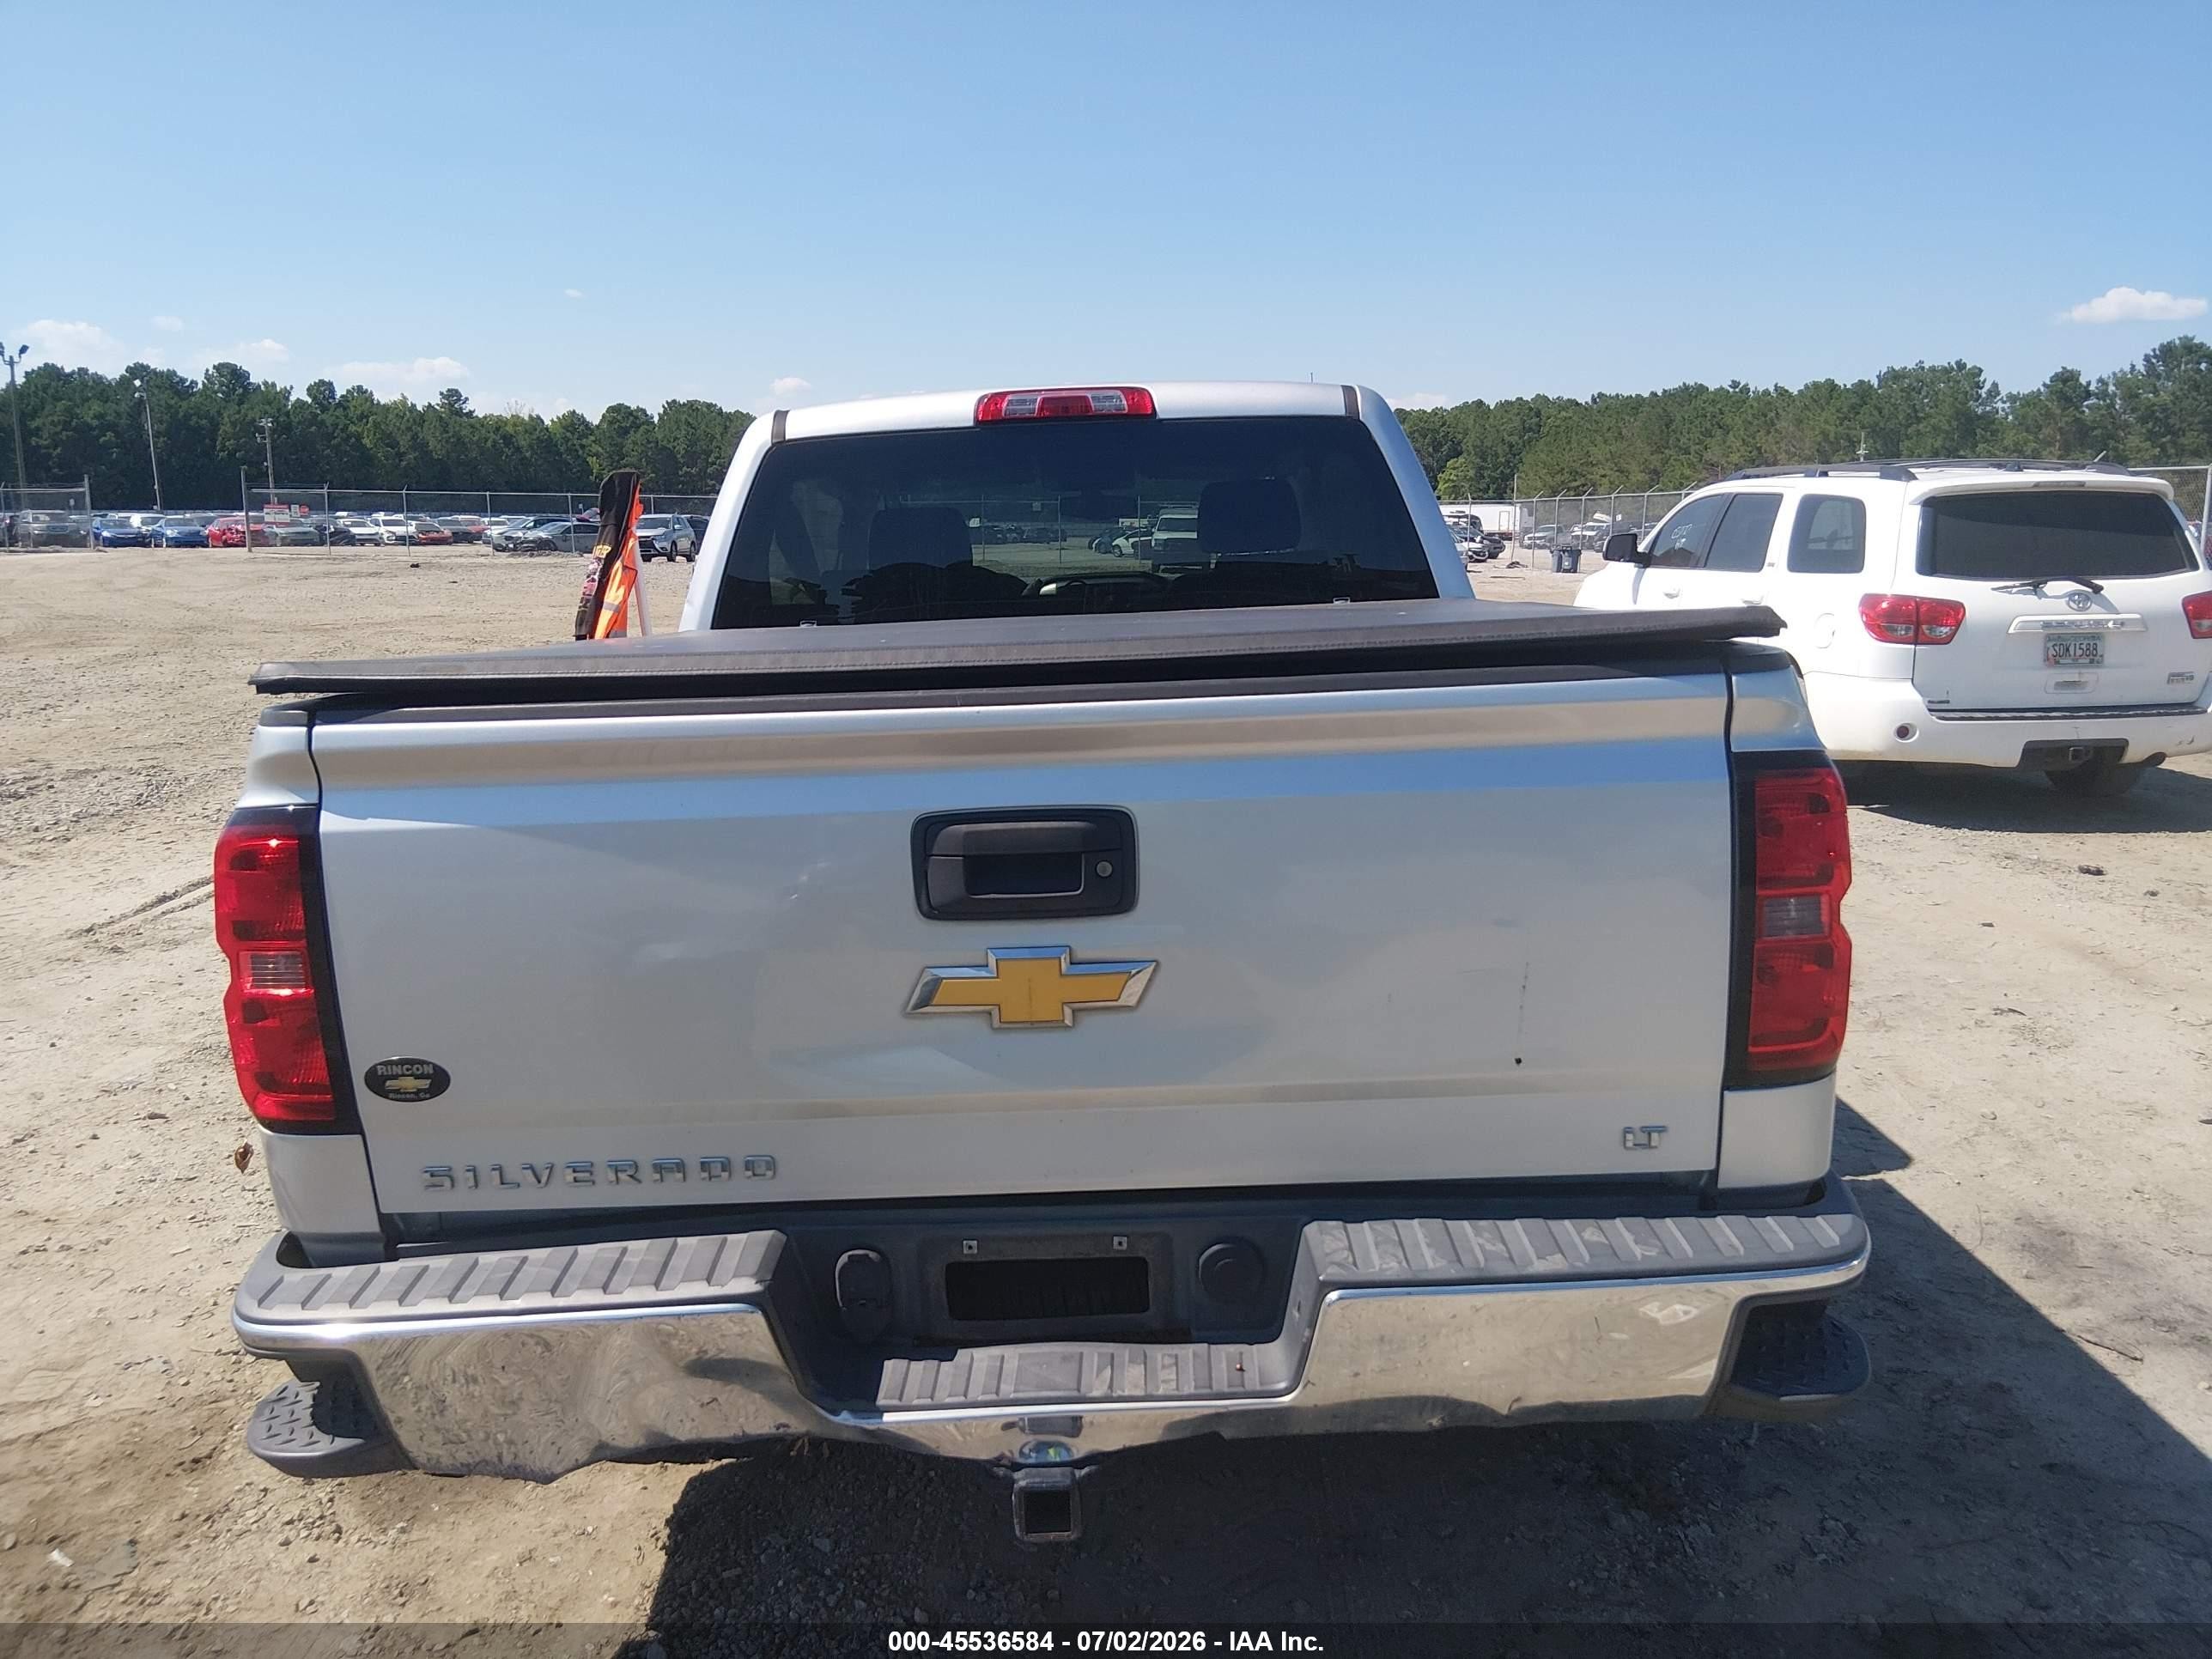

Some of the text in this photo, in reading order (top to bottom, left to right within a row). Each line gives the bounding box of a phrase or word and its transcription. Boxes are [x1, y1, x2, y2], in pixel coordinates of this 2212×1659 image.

[376, 1064, 434, 1076] RINCON
[1624, 1126, 1667, 1150] LT
[422, 1154, 777, 1191] SILVERADO
